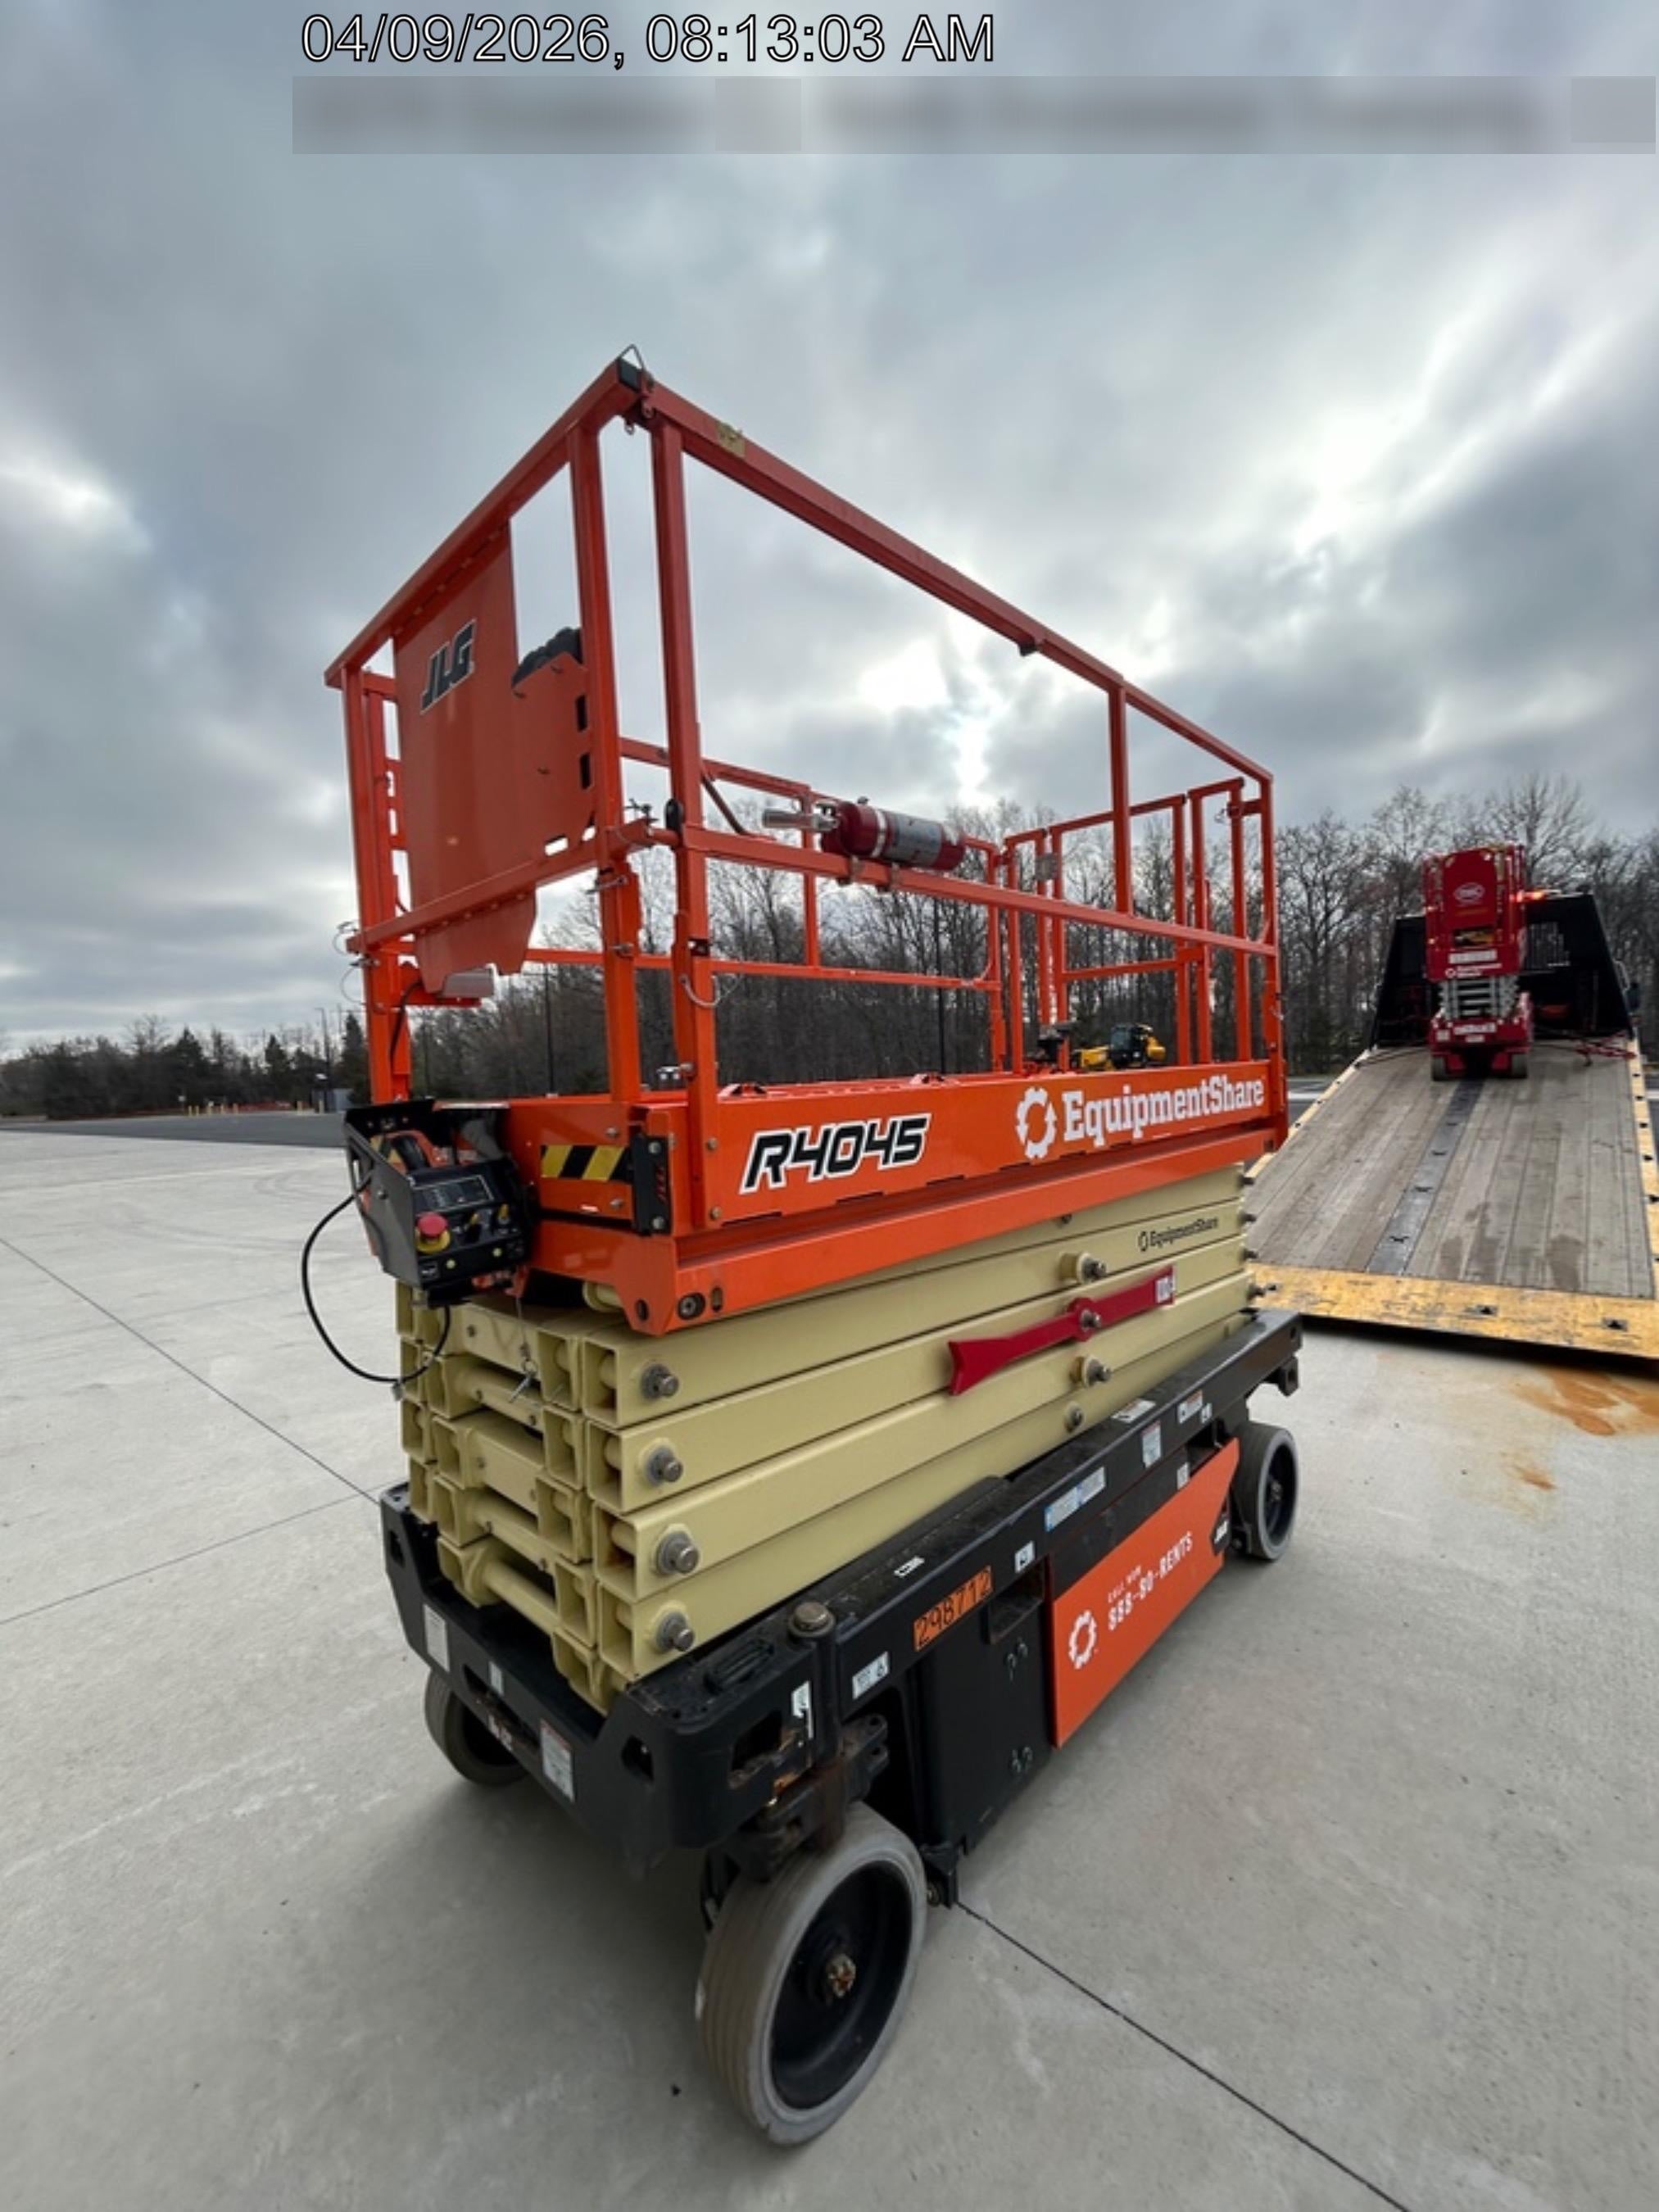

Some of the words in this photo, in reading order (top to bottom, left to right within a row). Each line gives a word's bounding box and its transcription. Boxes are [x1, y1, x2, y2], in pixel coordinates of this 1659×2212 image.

[422, 620, 476, 713] JLG
[1061, 1074, 1265, 1147] EquipmentShare
[741, 1113, 931, 1194] R4045
[1149, 1217, 1219, 1249] EquipmentShare
[915, 1567, 992, 1647] 298712
